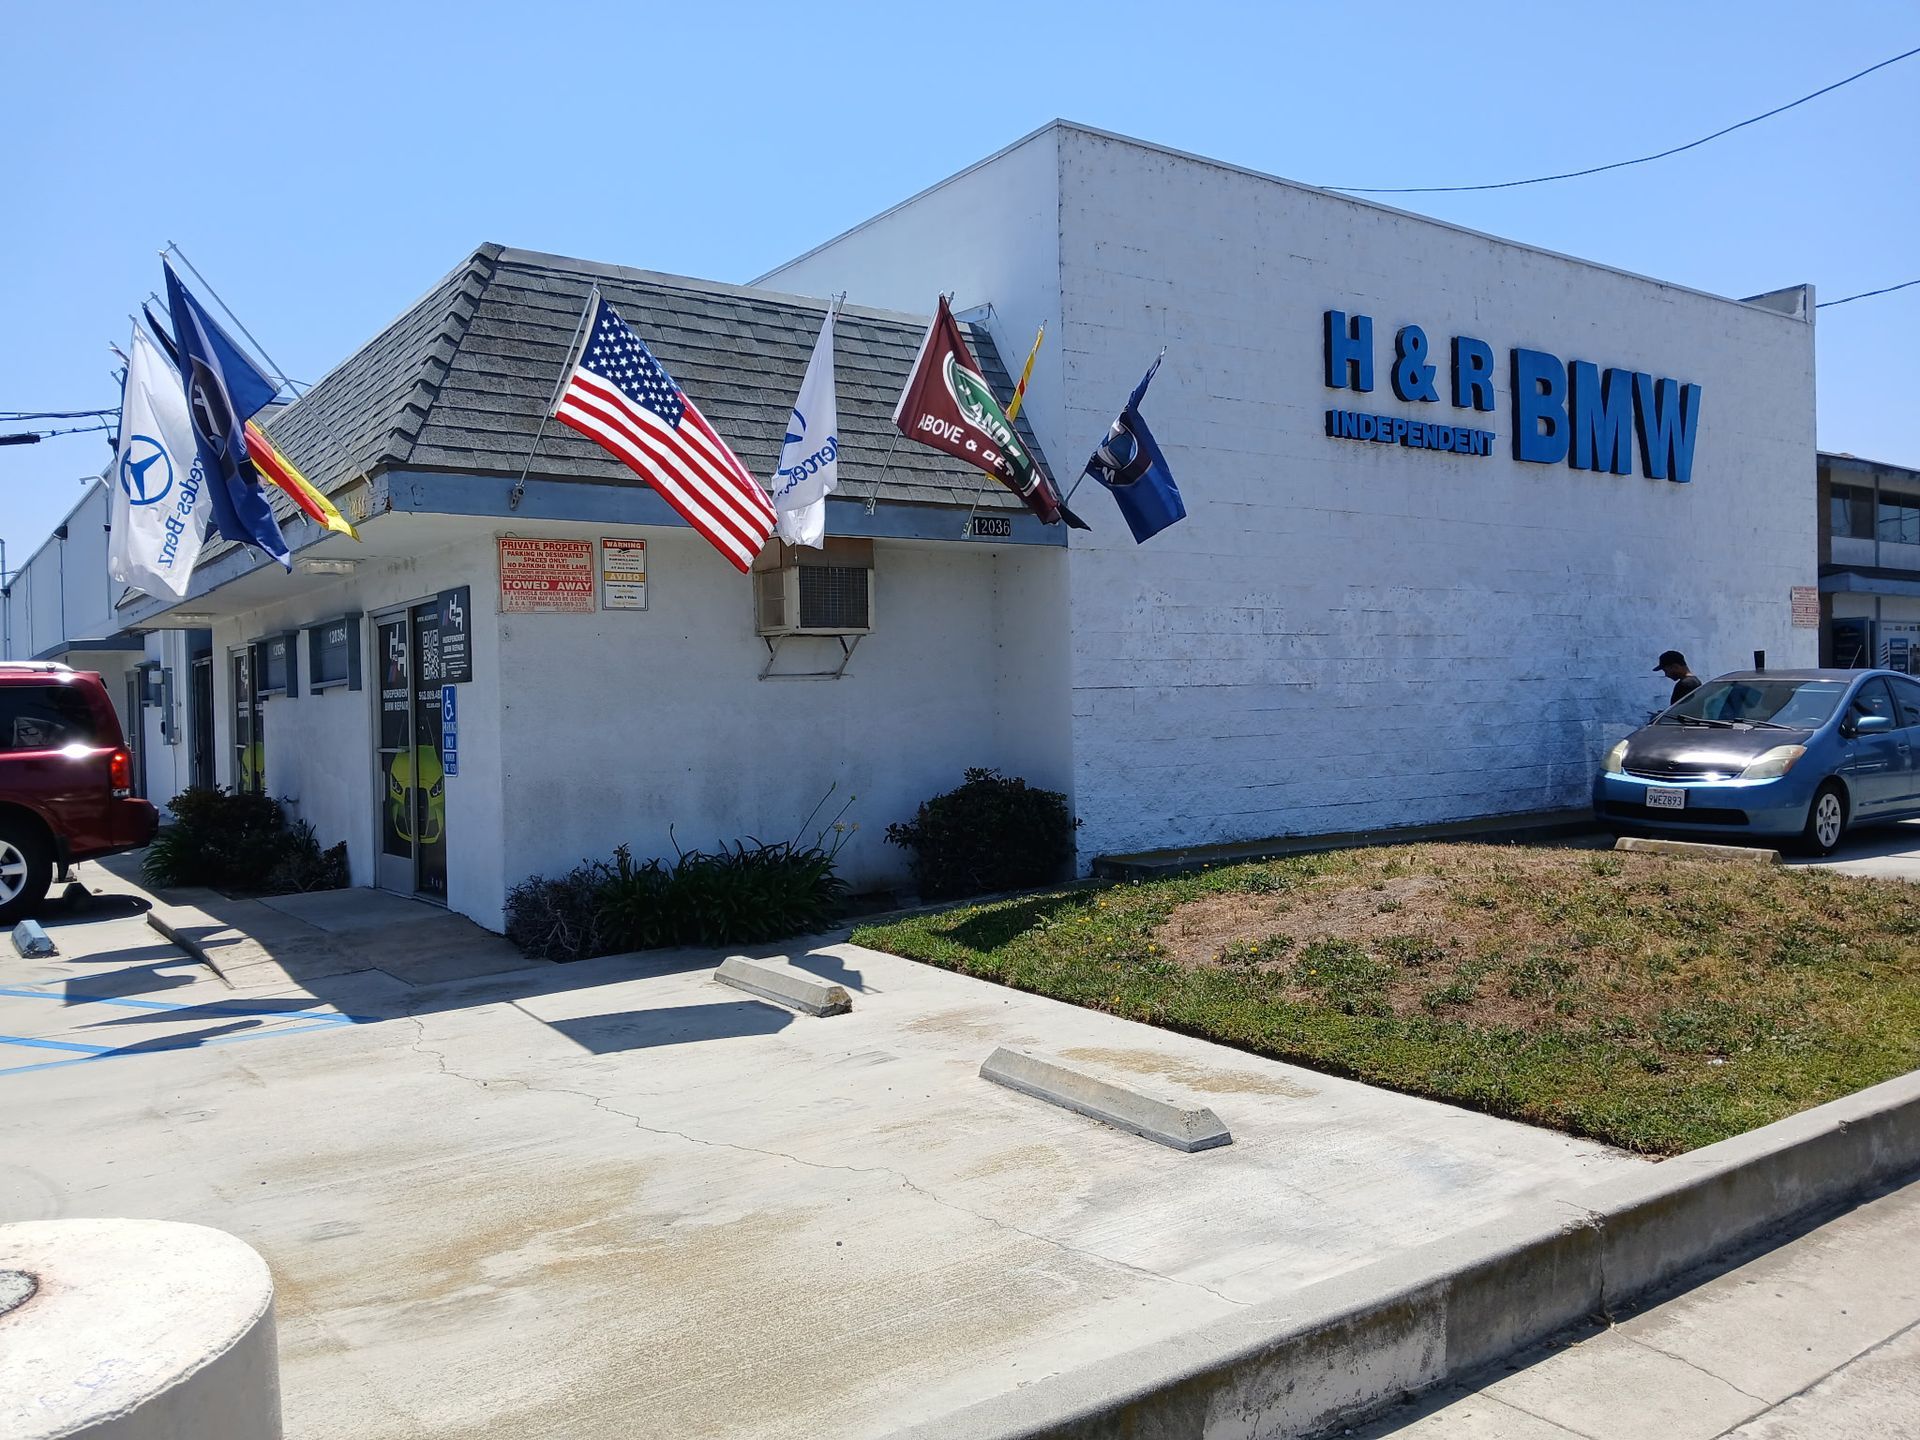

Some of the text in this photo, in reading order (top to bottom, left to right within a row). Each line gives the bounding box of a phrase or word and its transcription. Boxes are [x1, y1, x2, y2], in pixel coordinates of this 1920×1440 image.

[1324, 309, 1495, 411] H & R
[1510, 347, 1702, 483] BMW
[917, 413, 965, 445] ABOVE
[965, 438, 978, 452] &
[1325, 409, 1496, 457] INDEPENDENT
[974, 518, 1010, 536] 12036
[502, 541, 590, 551] PRIVATE PROPERTY
[606, 541, 641, 549] WARNING
[610, 573, 640, 581] AVISO
[503, 580, 591, 591] TOWED AWAY
[1648, 794, 1682, 806] 9WEZ893
